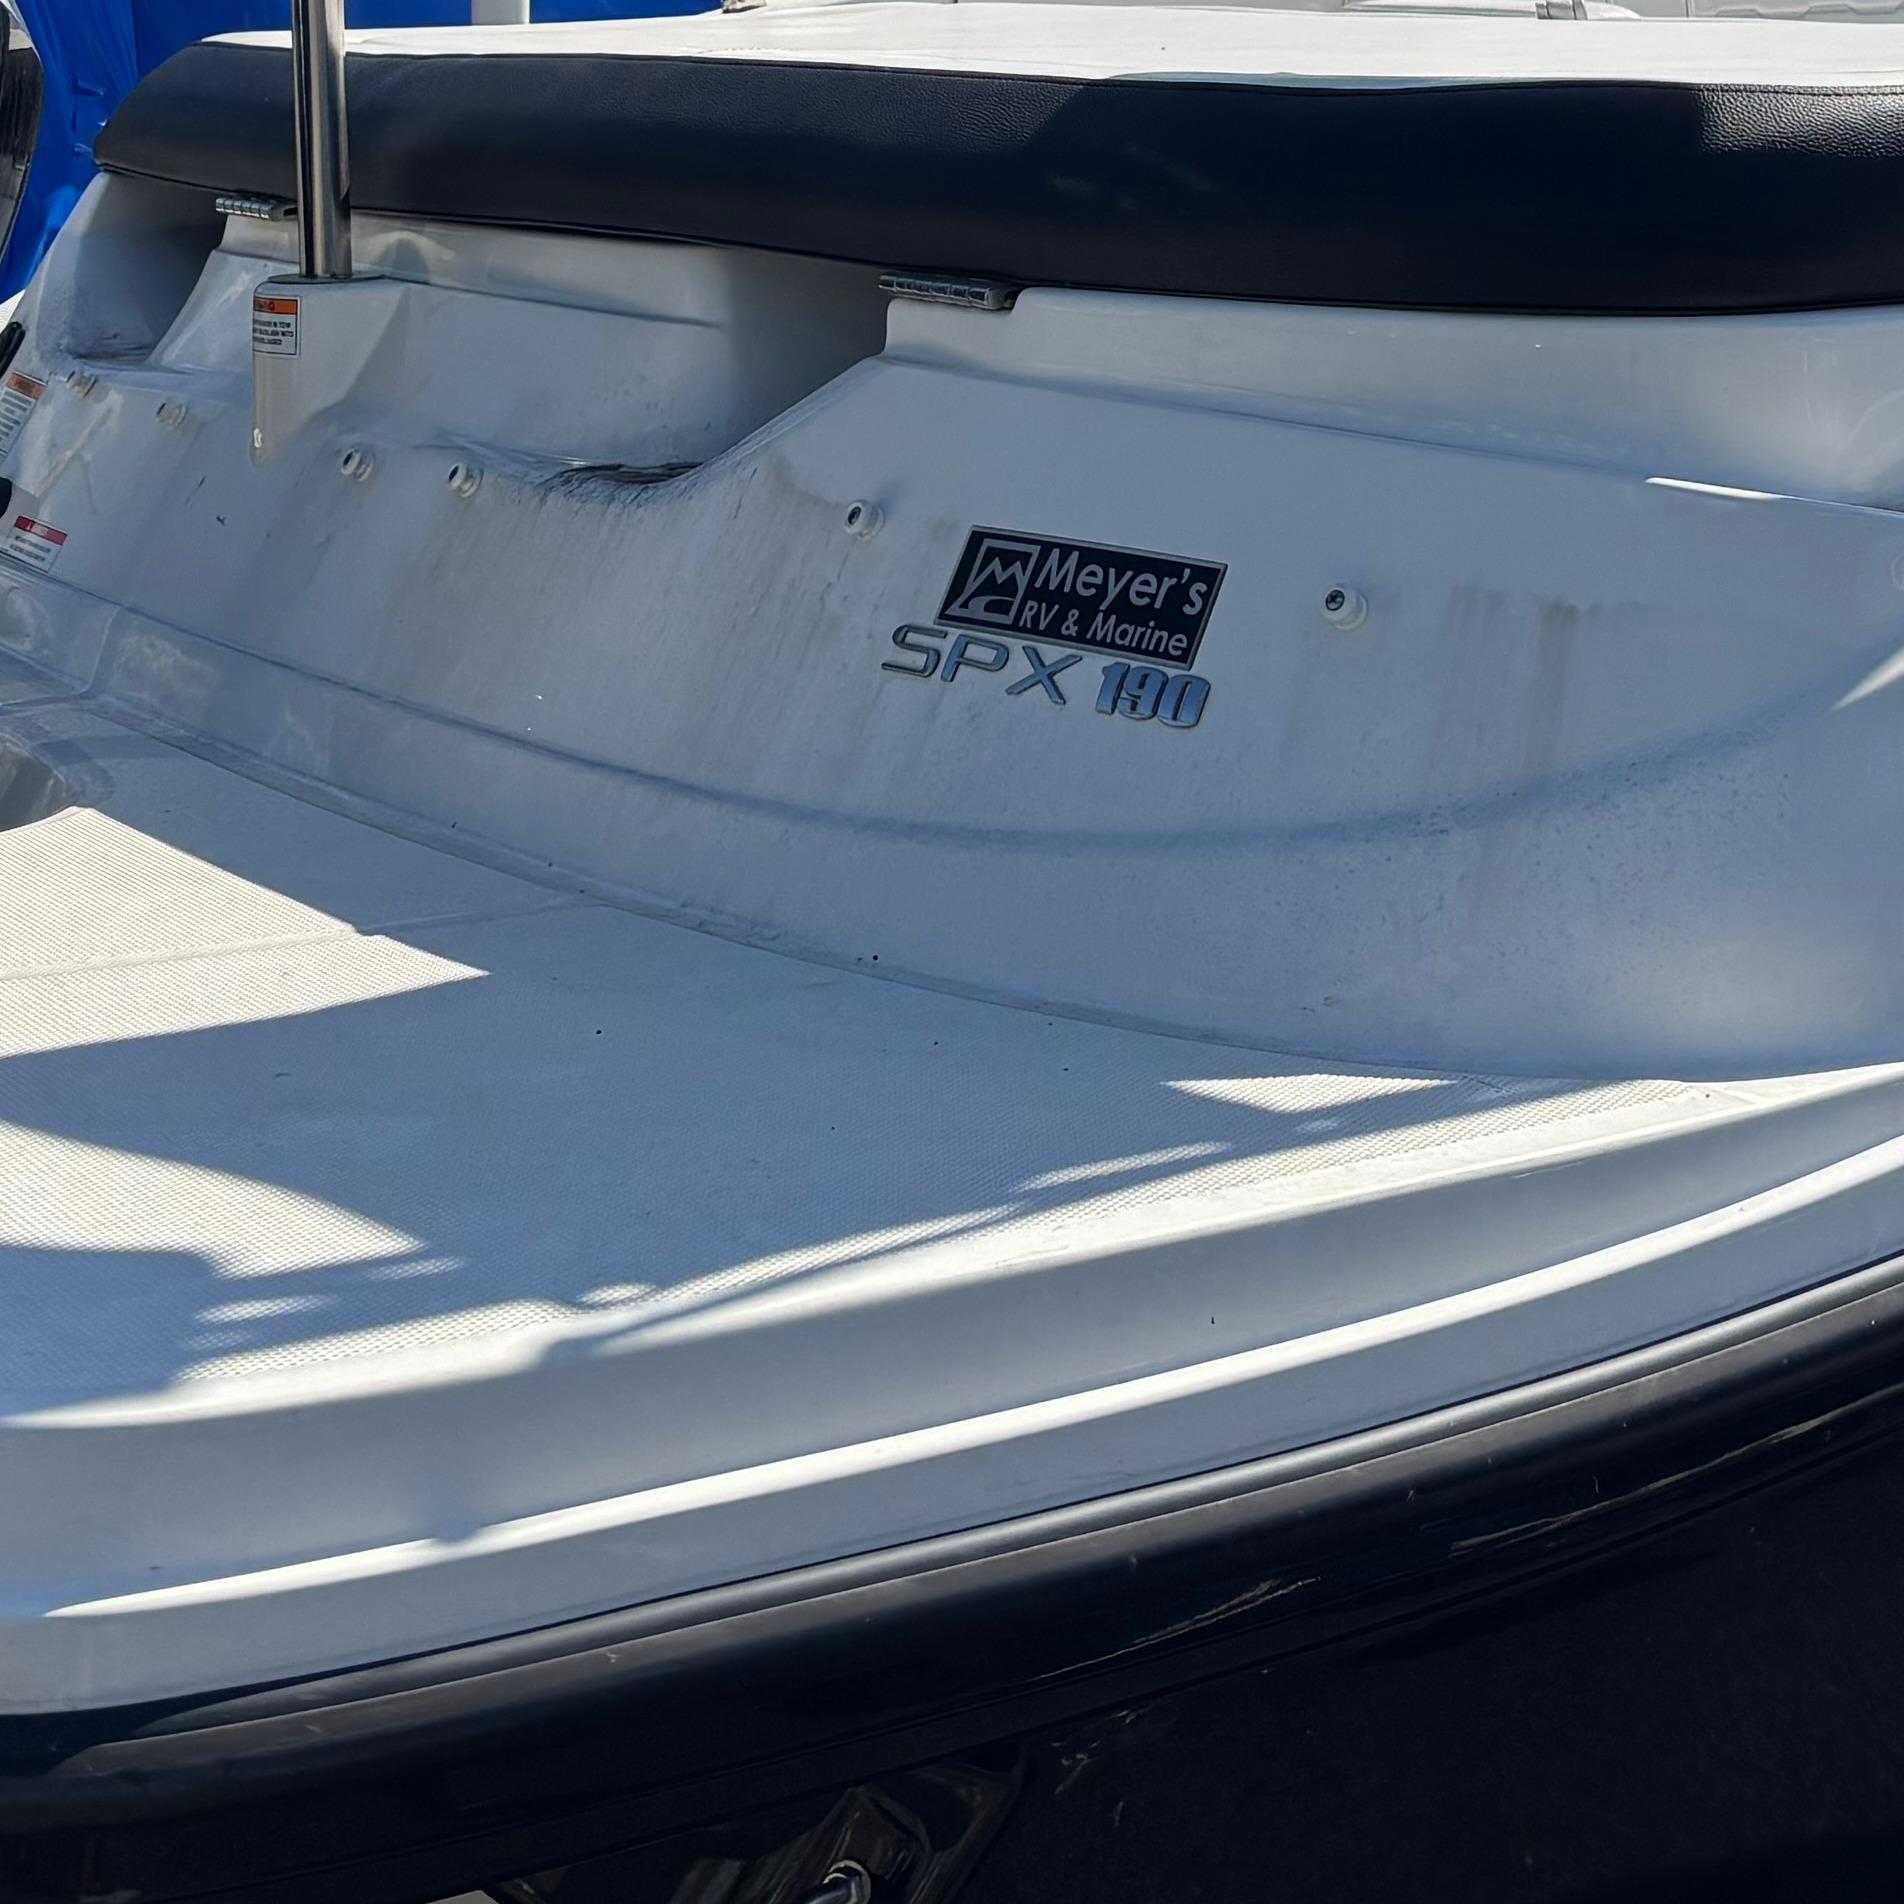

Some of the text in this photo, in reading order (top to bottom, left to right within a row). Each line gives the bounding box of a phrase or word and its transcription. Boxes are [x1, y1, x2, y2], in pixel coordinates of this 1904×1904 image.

[1034, 547, 1209, 616] Meyer's
[1019, 600, 1189, 656] RV & Marine
[881, 624, 1212, 729] SPX 190
